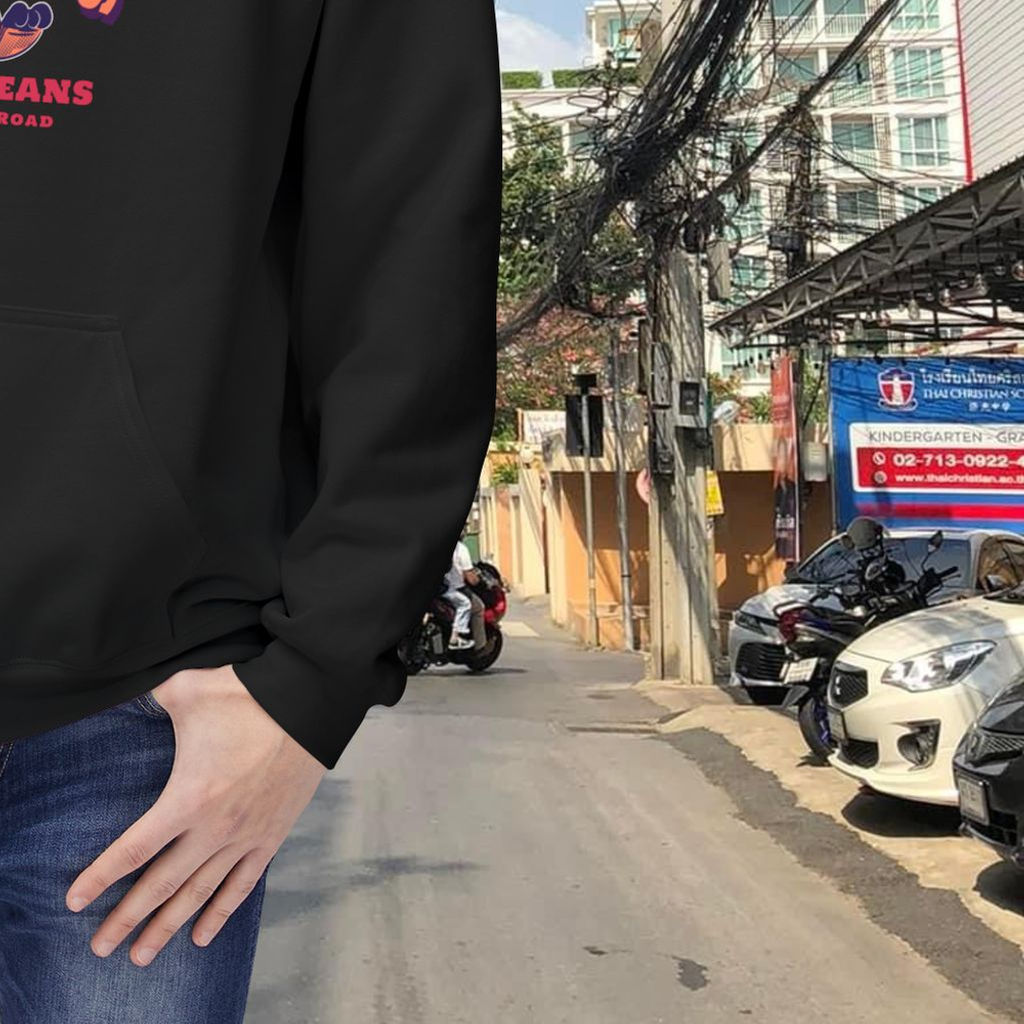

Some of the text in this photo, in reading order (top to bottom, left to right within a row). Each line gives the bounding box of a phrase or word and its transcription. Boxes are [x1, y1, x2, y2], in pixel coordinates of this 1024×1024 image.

[923, 388, 949, 399] THAI
[949, 388, 1009, 400] CHRISTIAN
[868, 430, 982, 444] KINDERGARTEN
[895, 473, 1024, 484] www.thaichristian.ac.t
